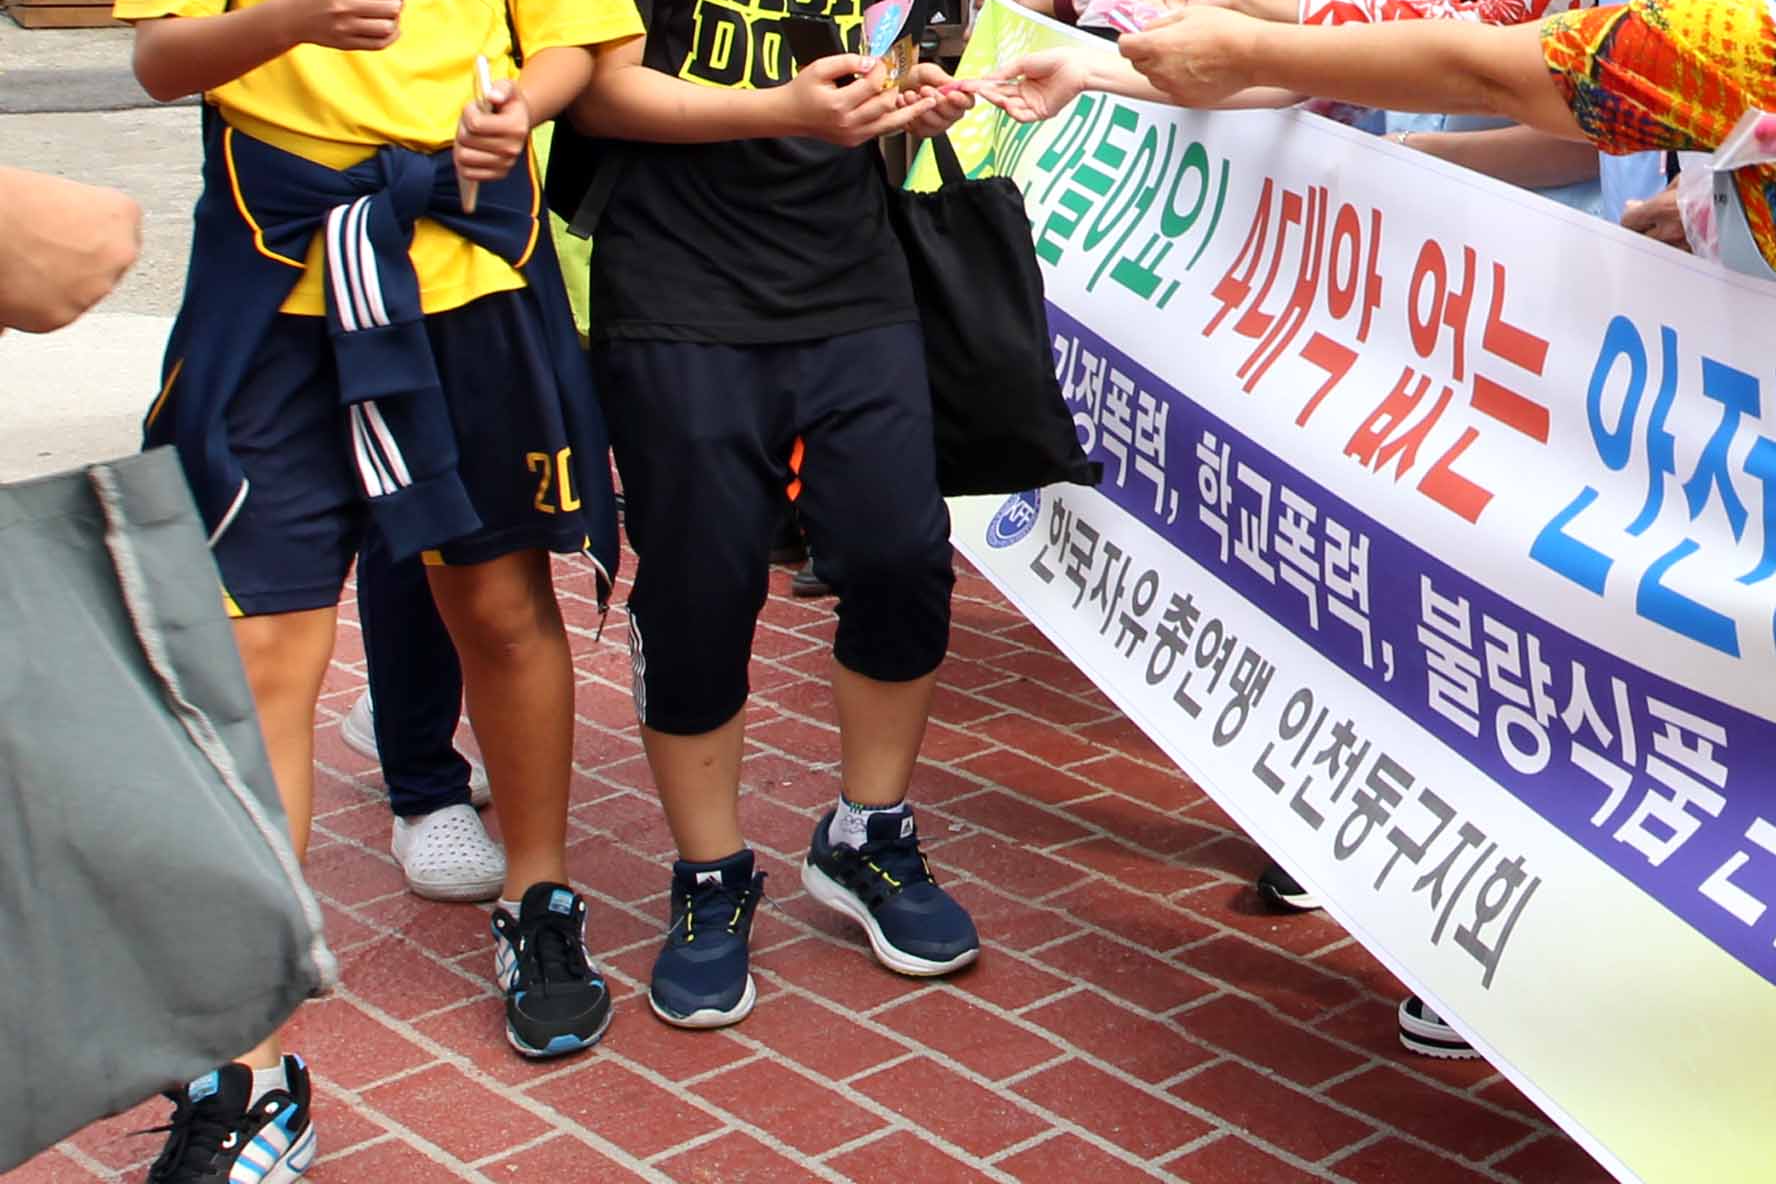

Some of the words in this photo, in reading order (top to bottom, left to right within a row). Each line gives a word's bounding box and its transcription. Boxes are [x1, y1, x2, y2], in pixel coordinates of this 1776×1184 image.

[1202, 177, 1383, 427] 4대악
[1343, 239, 1550, 524] 없는
[1030, 495, 1277, 748] 한국자유총연맹
[1253, 686, 1543, 990] 인천동구지회
[1197, 431, 1395, 684] 학교폭력,
[1417, 574, 1728, 867] 불량식품
